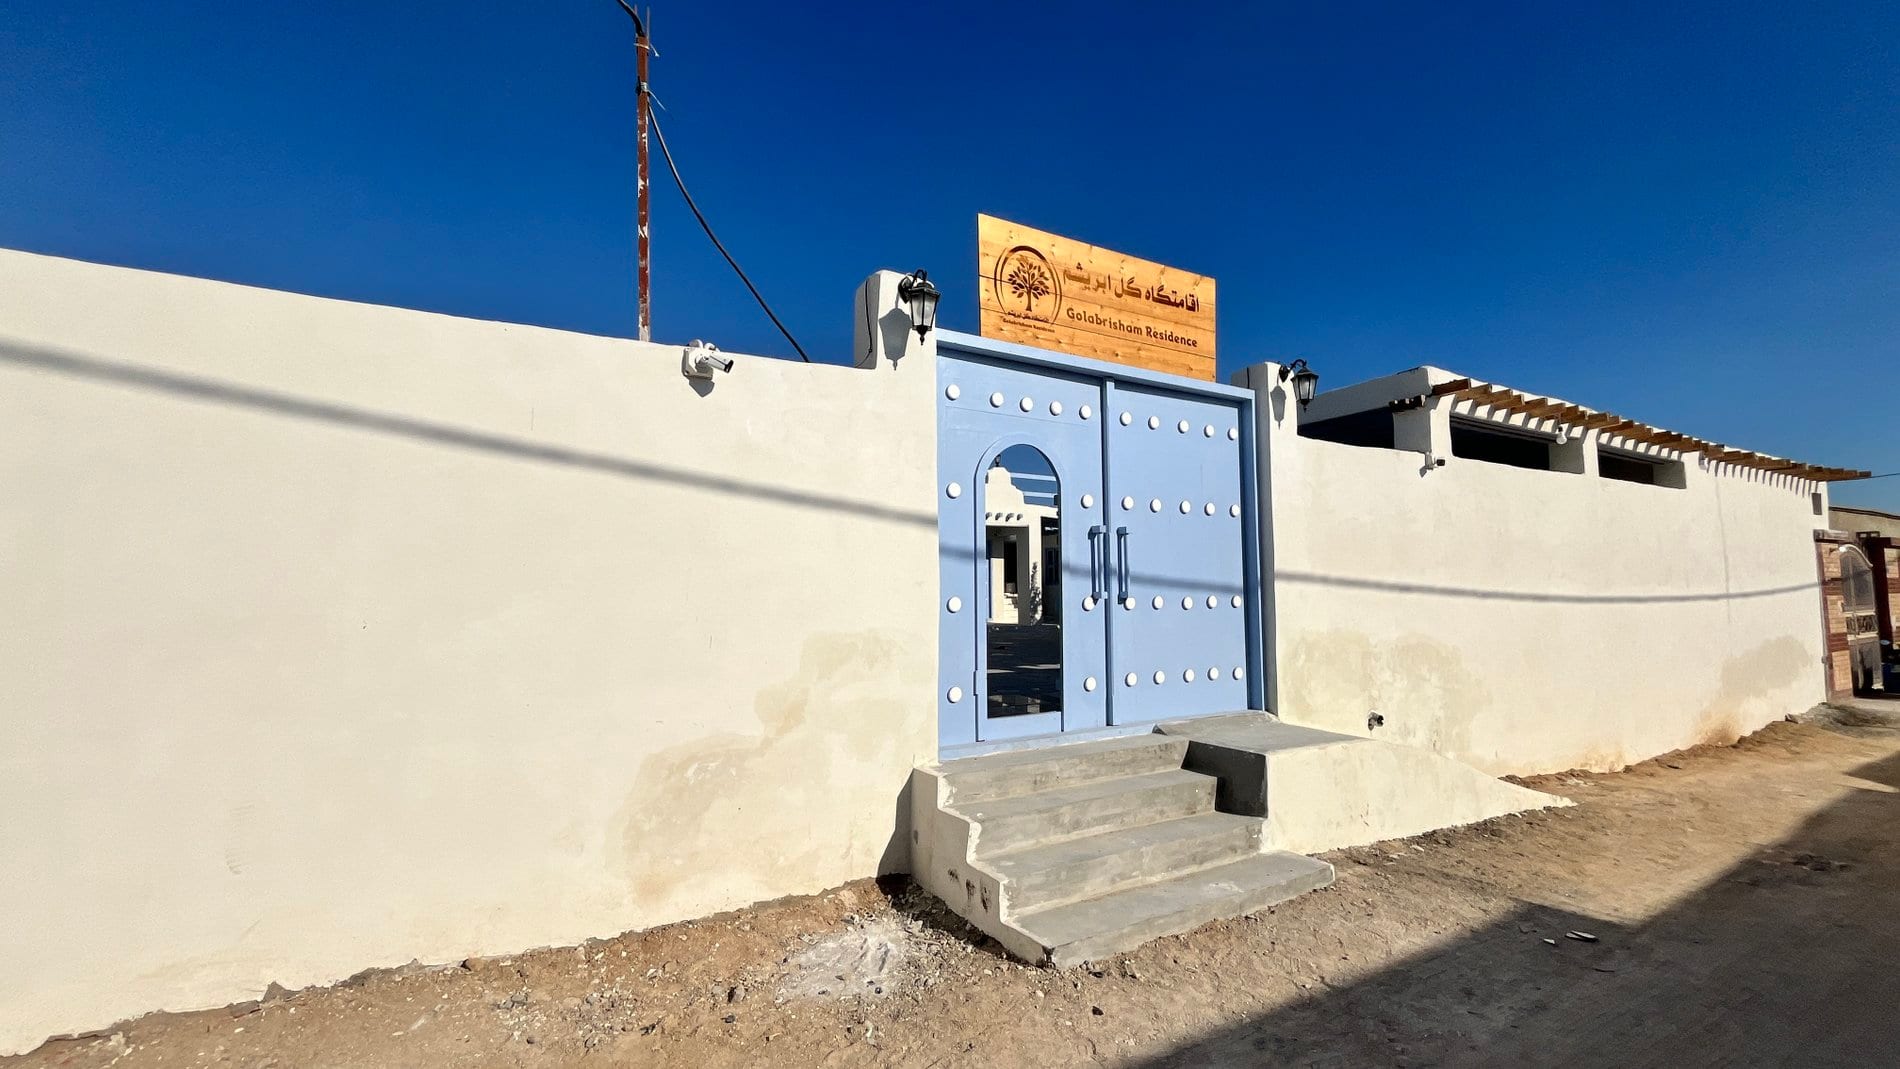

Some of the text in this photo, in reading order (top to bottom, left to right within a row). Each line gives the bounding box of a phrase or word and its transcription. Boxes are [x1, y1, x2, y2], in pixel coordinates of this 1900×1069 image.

[1063, 262, 1200, 313] اقامتگاه گل ابریشم
[1066, 307, 1143, 336] Golabrisham
[1145, 326, 1198, 347] Residence
